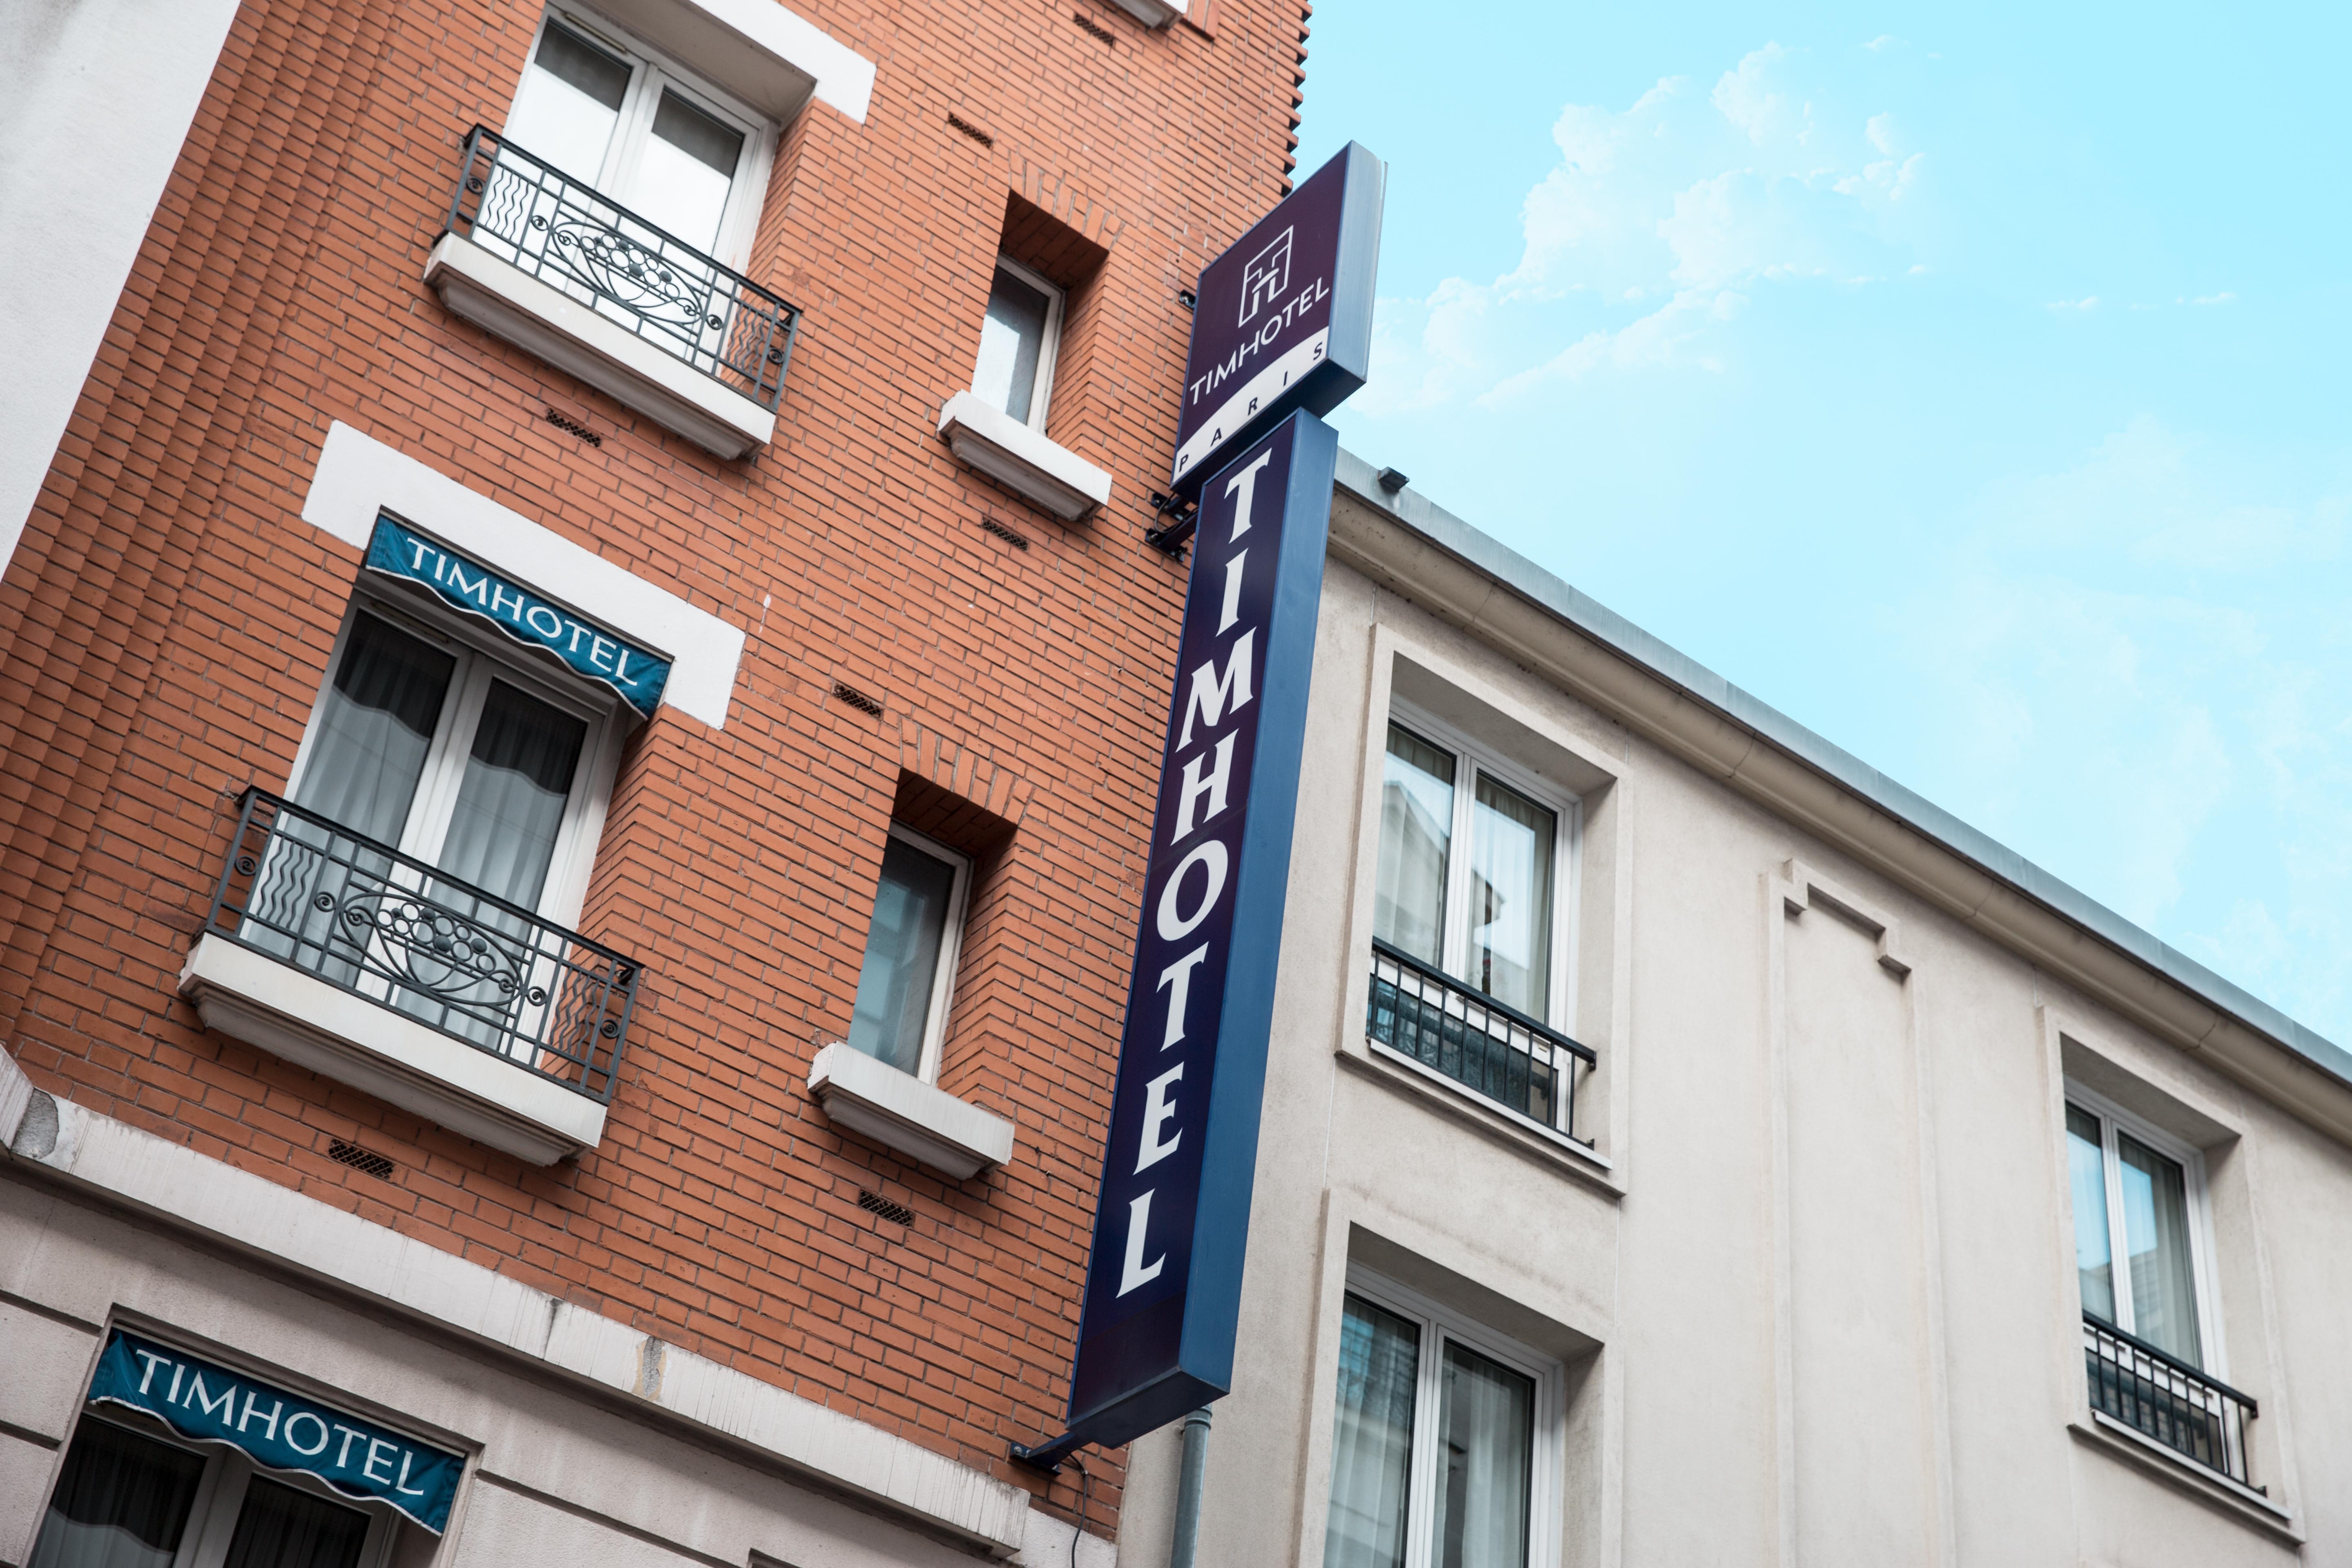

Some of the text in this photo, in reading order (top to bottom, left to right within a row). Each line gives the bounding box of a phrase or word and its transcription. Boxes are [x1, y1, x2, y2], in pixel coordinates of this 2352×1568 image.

[1178, 342, 1324, 472] PARIS
[1190, 277, 1330, 405] TIMHOTEL
[407, 537, 637, 686] TIMHOTEL
[1115, 448, 1271, 1298] TIMHOTEL
[136, 1349, 423, 1495] TIMHOTEL
